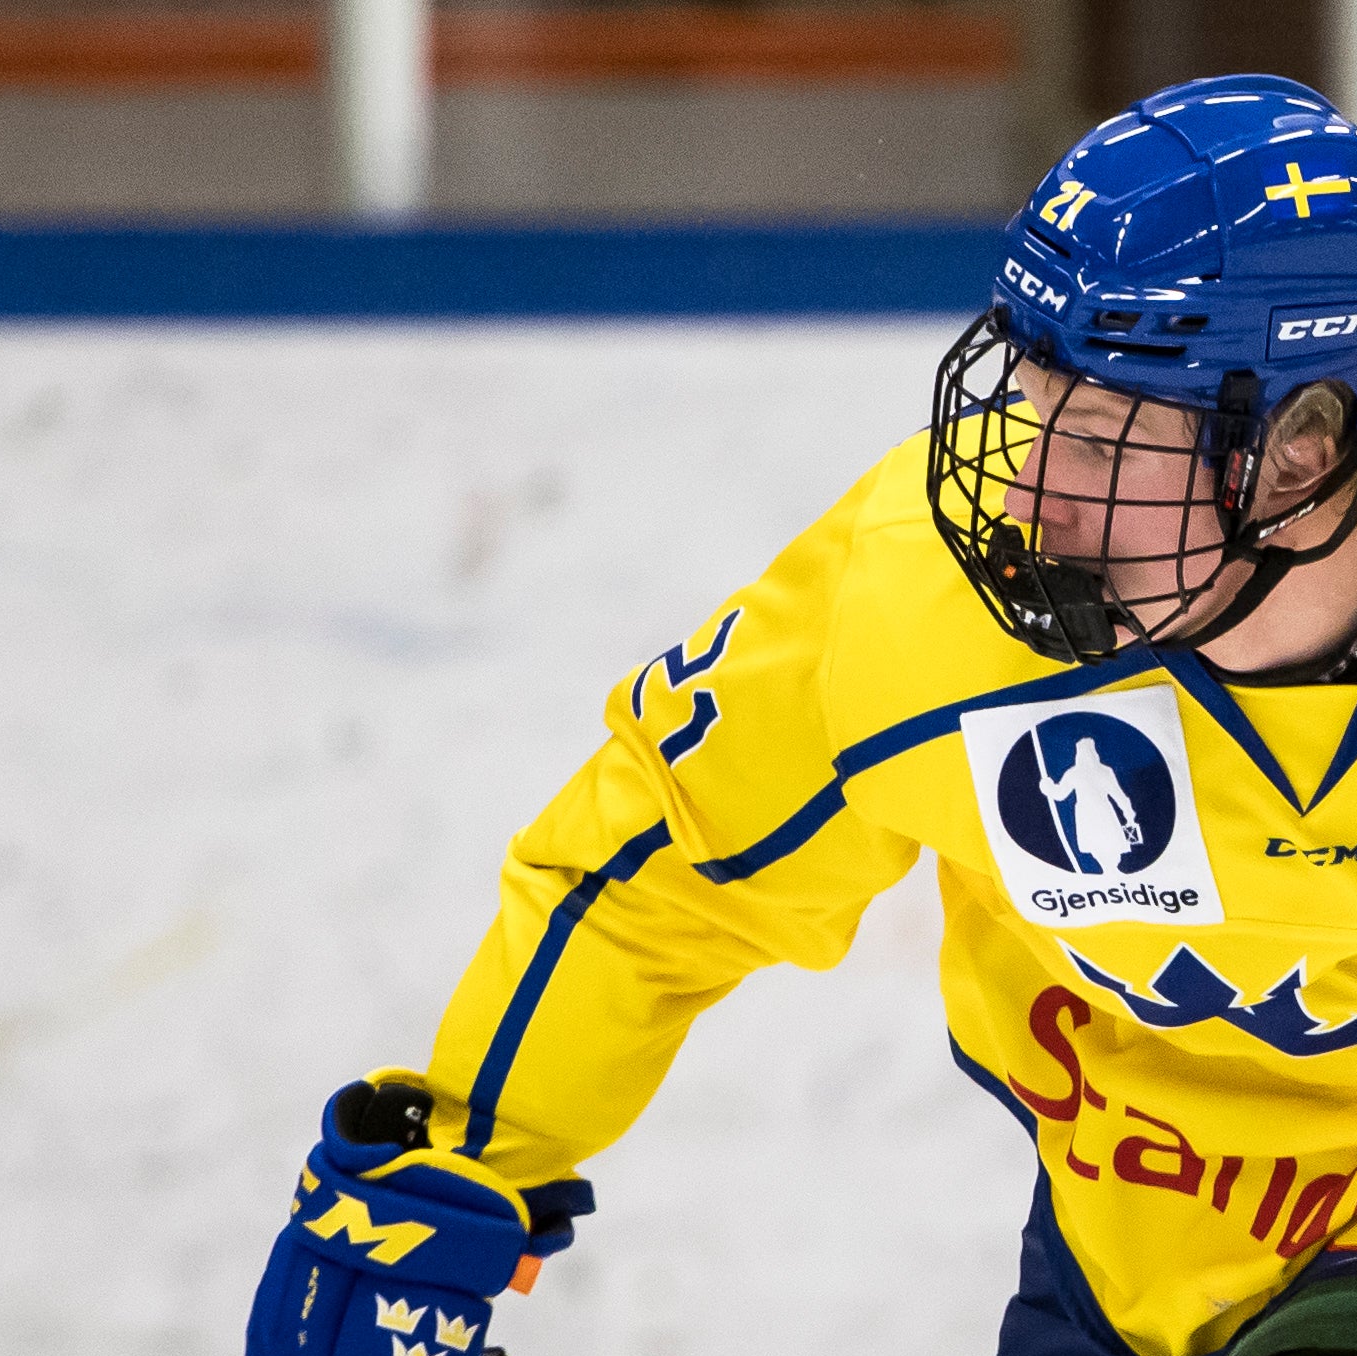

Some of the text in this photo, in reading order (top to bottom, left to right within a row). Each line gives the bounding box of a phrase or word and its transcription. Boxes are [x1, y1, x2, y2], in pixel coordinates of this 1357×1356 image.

[1039, 180, 1098, 232] 21
[1004, 257, 1068, 313] CCM
[1031, 882, 1200, 918] Gjensidige
